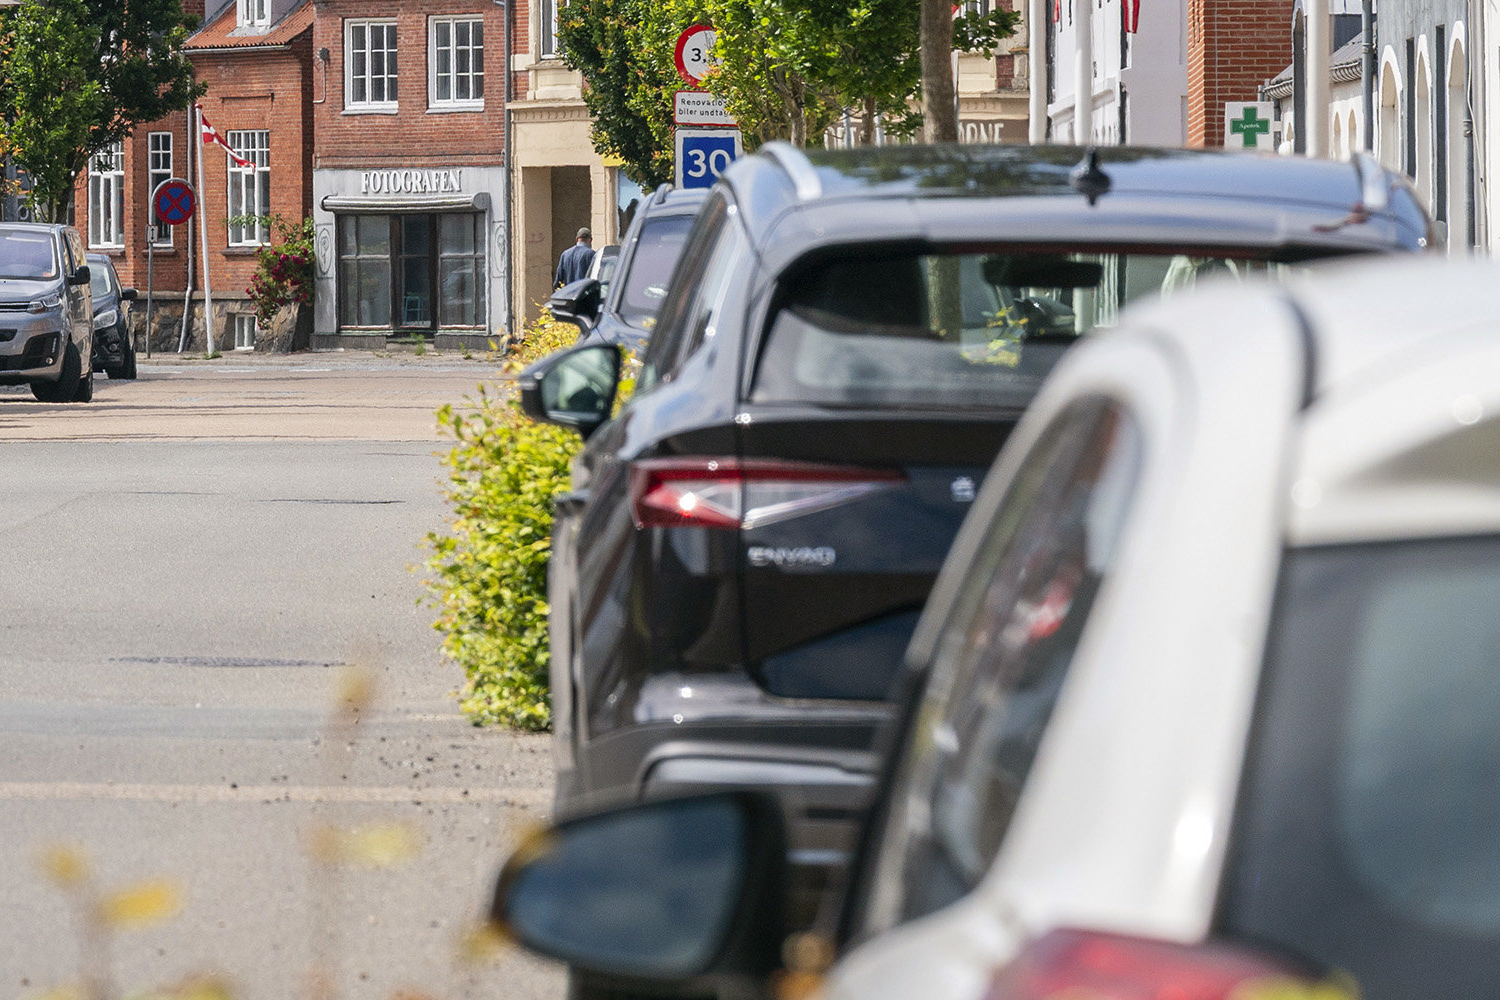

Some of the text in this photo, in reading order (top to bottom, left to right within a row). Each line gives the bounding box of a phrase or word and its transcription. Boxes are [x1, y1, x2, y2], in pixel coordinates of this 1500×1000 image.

[681, 98, 726, 106] Renovatio
[687, 149, 732, 179] 30
[361, 170, 462, 194] FOTOGRAFEN
